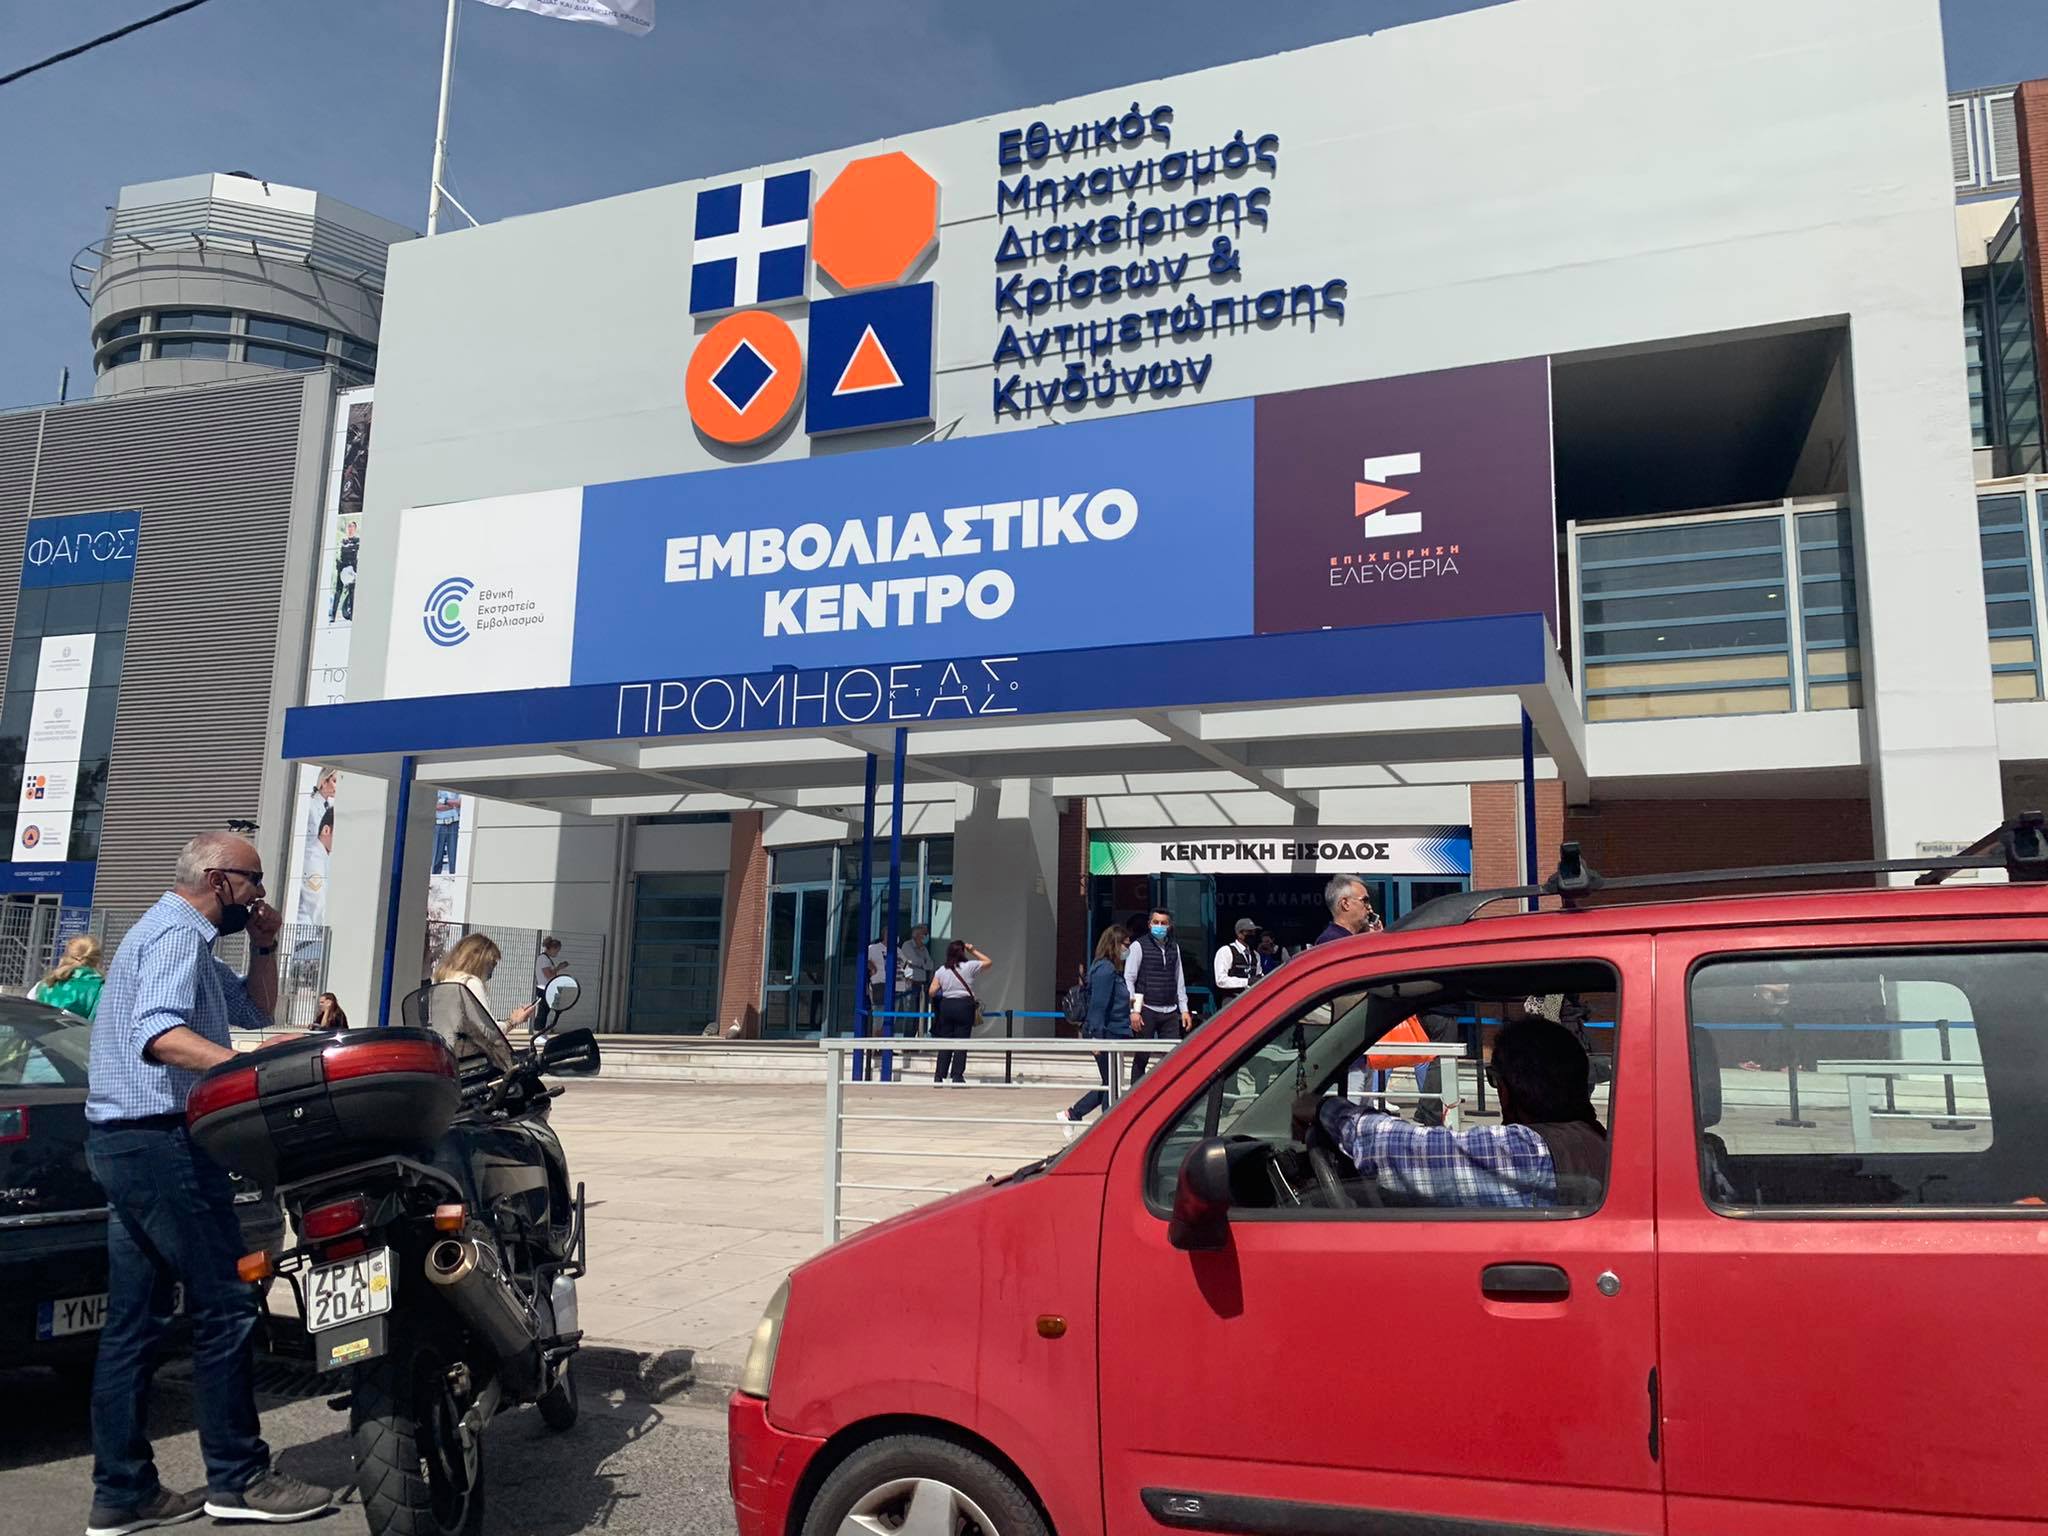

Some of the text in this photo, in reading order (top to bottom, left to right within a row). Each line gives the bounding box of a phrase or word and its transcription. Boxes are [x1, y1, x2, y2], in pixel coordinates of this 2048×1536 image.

[998, 101, 1174, 167] Εθνικός
[997, 129, 1279, 216] Μηχανισμός
[994, 186, 1271, 261] Διαχείρισης
[995, 235, 1241, 319] Κρίσεων &
[993, 278, 1348, 363] Αντιμετώπισης
[993, 353, 1213, 414] Κινδύνων
[28, 528, 136, 567] ΦΑΡΟΣ
[663, 487, 1139, 584] ΕΜΒΟΛΙΑΣΤΙΚΟ
[1330, 544, 1461, 567] ΕΠΙΧΕΙΡΗΣΗ
[479, 587, 514, 602] Εθνική
[1329, 556, 1460, 587] ΕΛΕΥΘΕΡΙΑ
[476, 612, 545, 631] Εμβολιασμού
[477, 600, 536, 616] Εκστρατεία
[762, 568, 1016, 638] ΚΕΝΤΡΟ
[616, 657, 1019, 735] ΠΡΟΜΗΘΕΑΣ
[1160, 842, 1391, 862] ΚΕΝΤΡΙΚΗ ΕΙΣΟΔΟΣ
[315, 1260, 367, 1297] ZPA
[315, 1288, 365, 1326] 204
